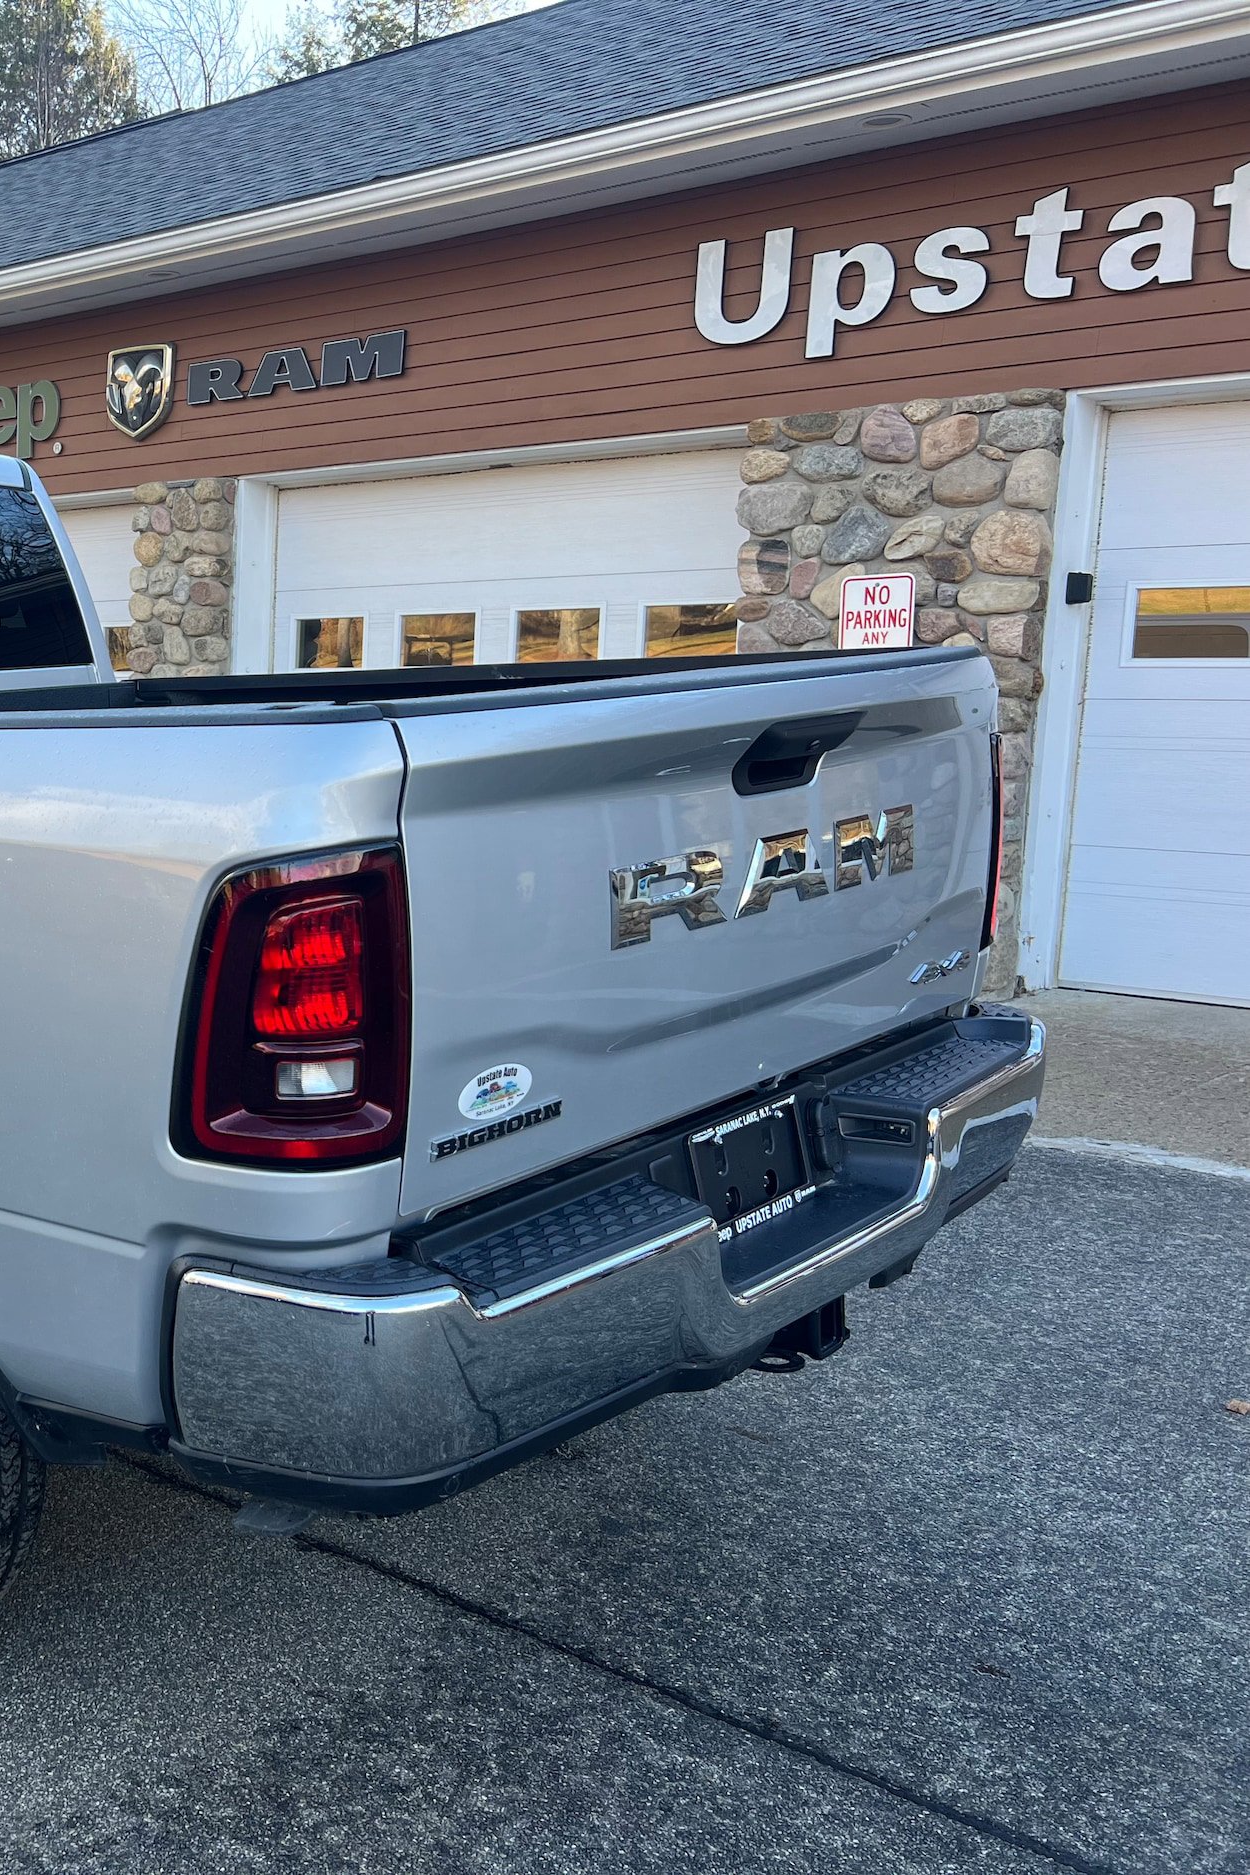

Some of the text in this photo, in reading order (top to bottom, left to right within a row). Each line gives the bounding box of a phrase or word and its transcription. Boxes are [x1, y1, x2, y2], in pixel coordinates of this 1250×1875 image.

[187, 329, 406, 406] RAM
[864, 585, 890, 606] NO
[845, 608, 907, 630] PARKING
[862, 631, 888, 645] ANY
[609, 804, 915, 951] RAM
[476, 1066, 518, 1088] Upstate Auto
[715, 1116, 743, 1137] SARANAC
[742, 1110, 760, 1125] LAKE,
[735, 1205, 772, 1234] UPSTATE
[771, 1194, 793, 1217] AUTO
